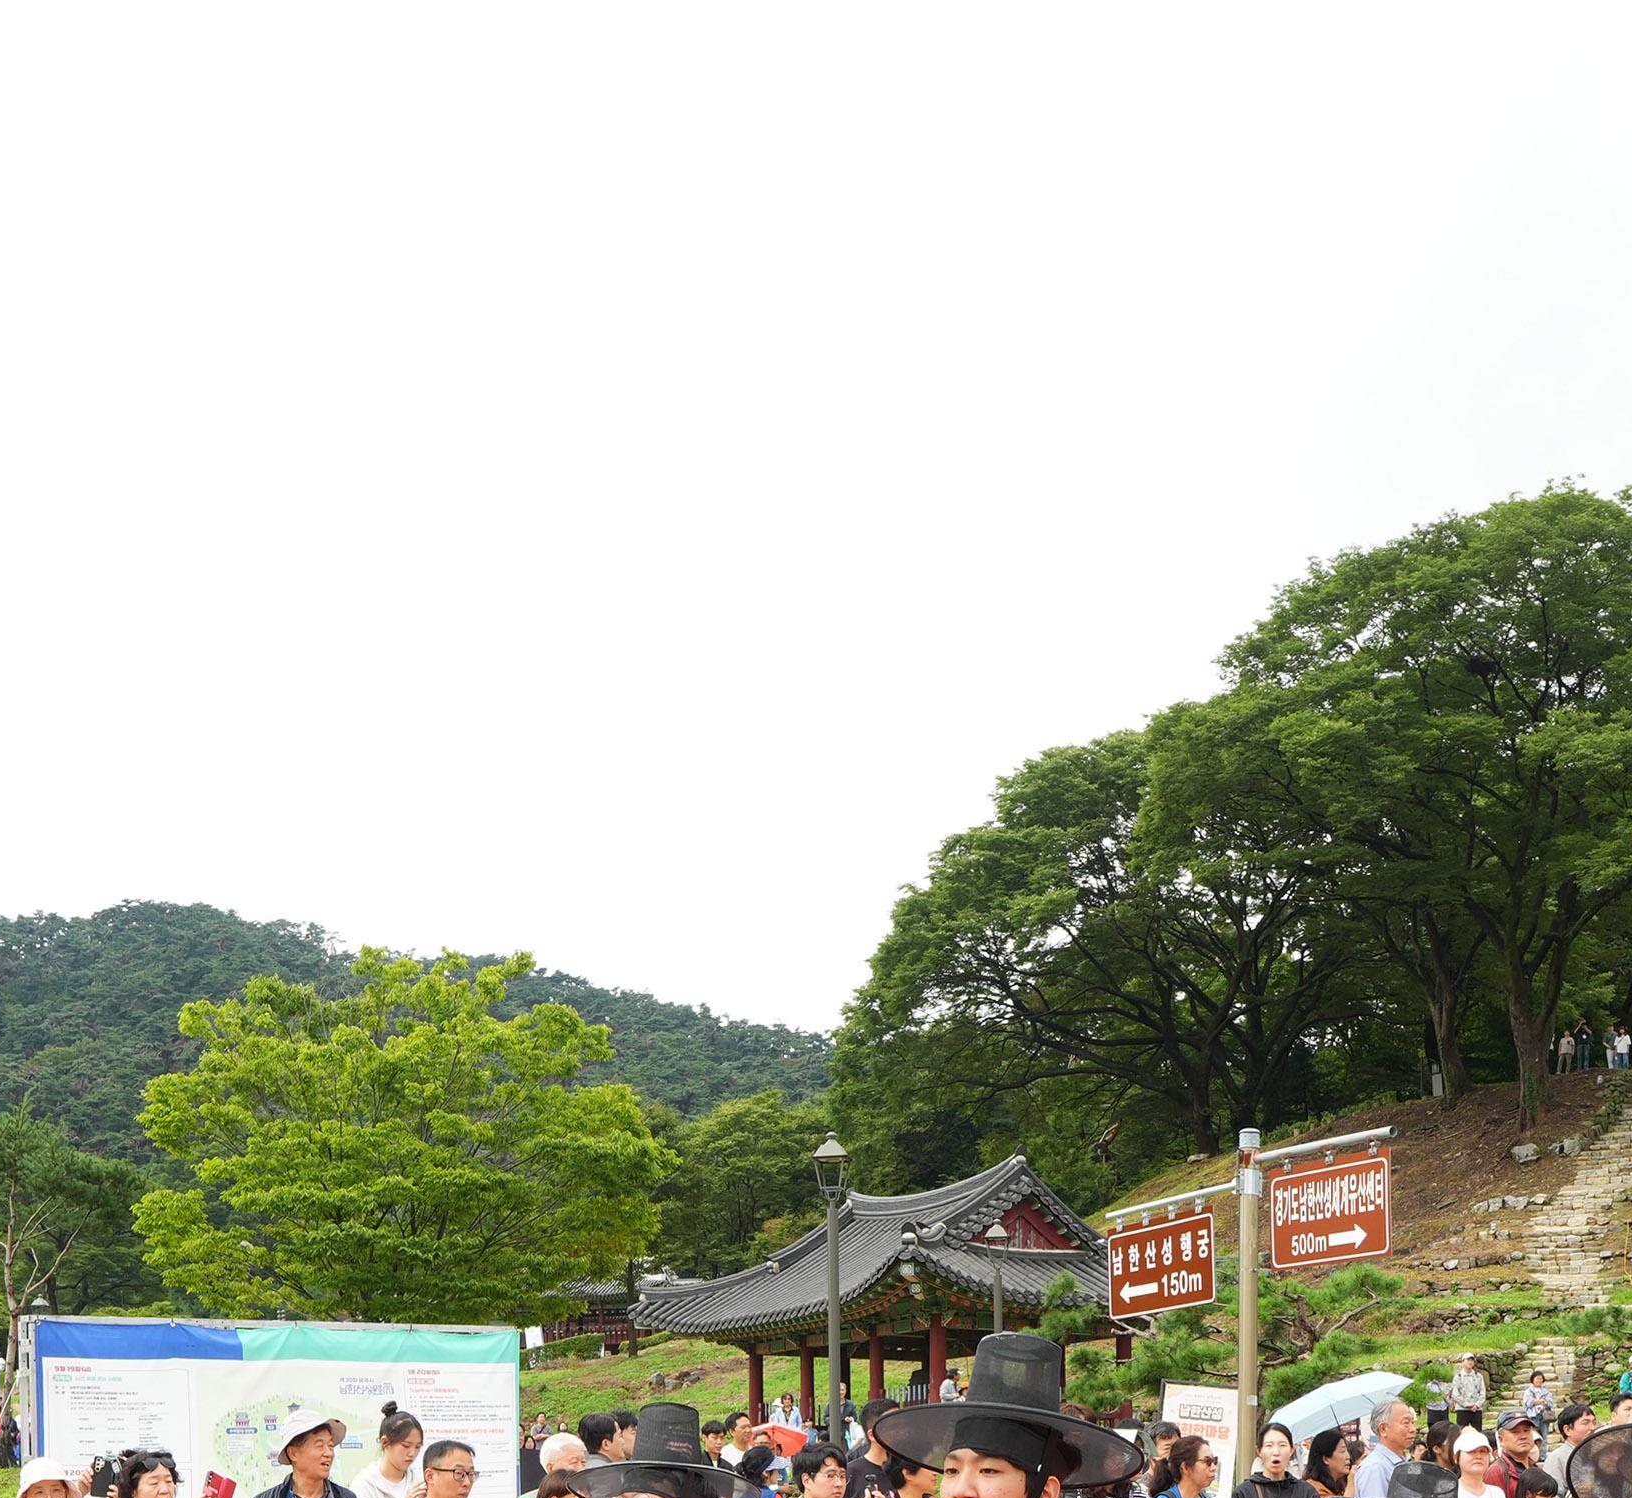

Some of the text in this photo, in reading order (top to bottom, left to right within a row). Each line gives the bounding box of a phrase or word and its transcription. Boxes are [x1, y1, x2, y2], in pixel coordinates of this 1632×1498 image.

[1275, 1168, 1384, 1227] 경기도남한산성세계유산센터
[1112, 1229, 1210, 1277] 남한산성 행궁
[1291, 1232, 1327, 1256] 500m
[1161, 1270, 1203, 1297] 150m
[1179, 1403, 1223, 1422] 남한산성
[1175, 1422, 1230, 1440] 희한마당
